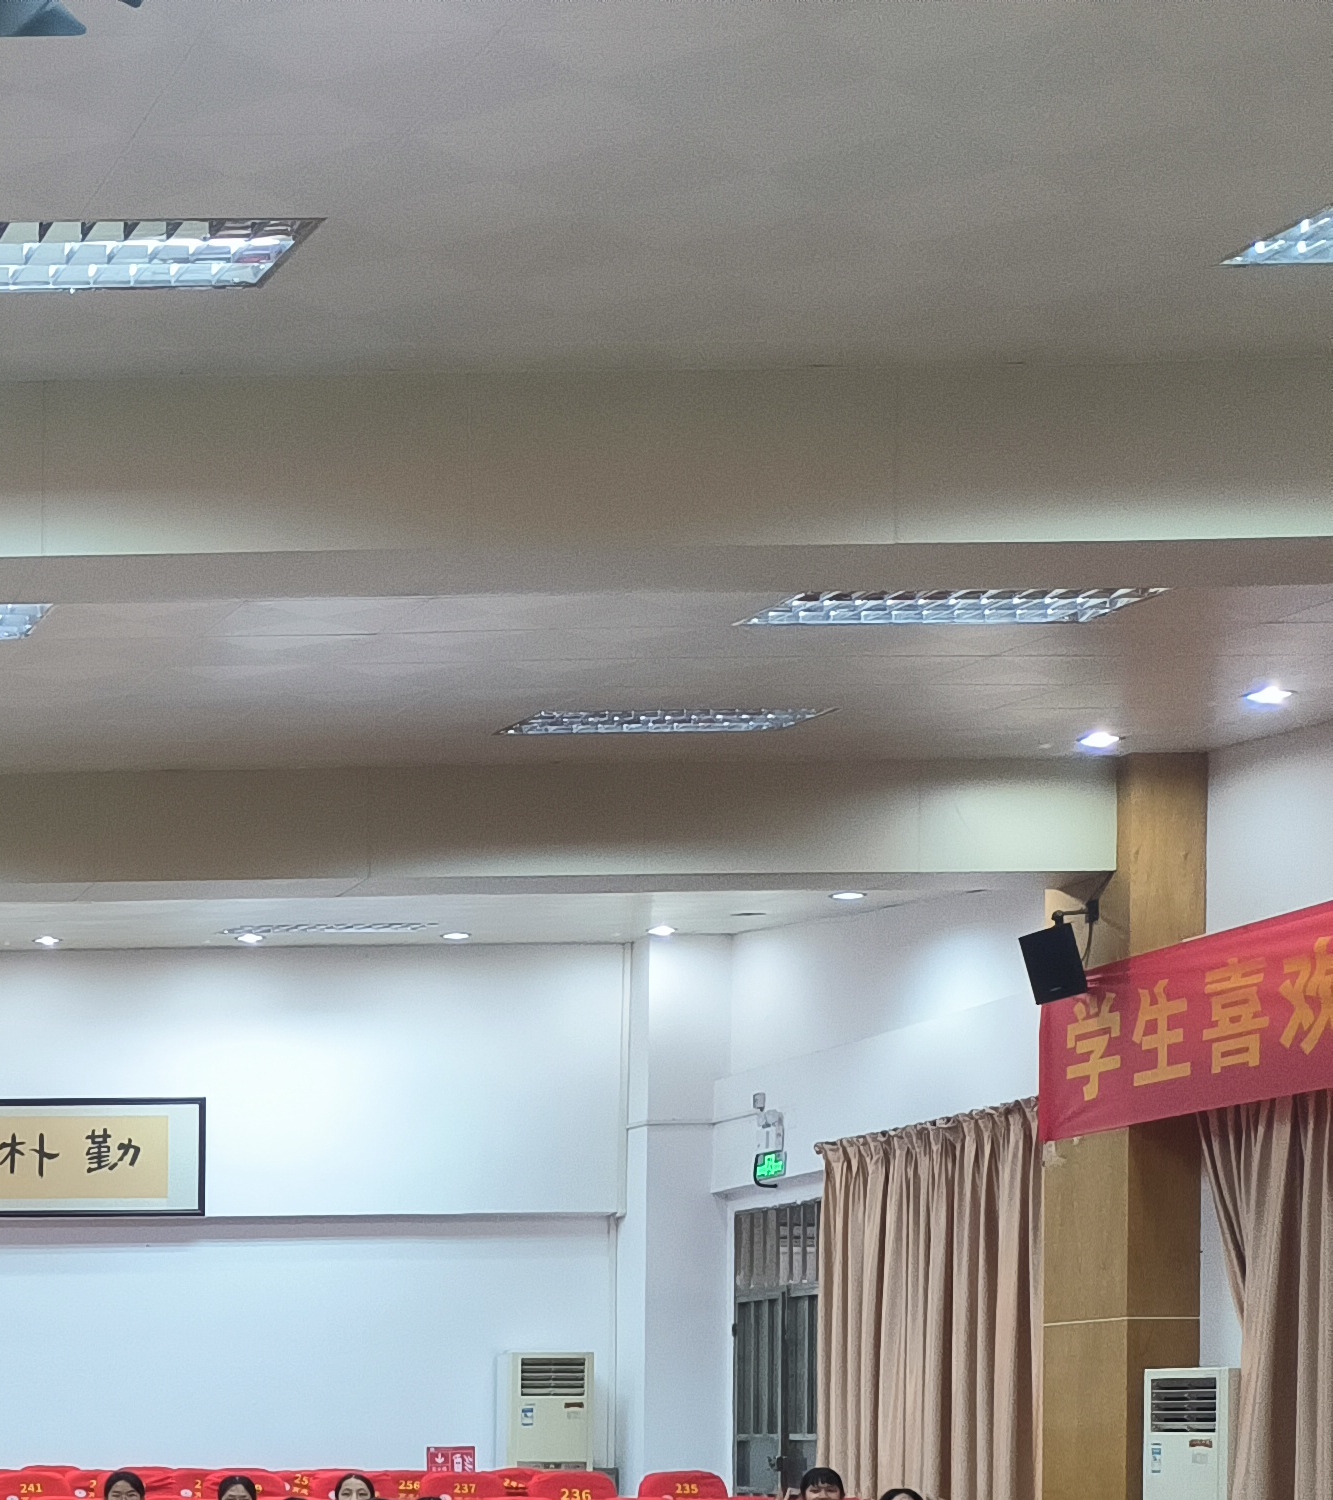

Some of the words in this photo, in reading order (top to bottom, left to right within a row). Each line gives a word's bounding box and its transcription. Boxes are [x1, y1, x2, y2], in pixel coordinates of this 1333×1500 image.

[20, 1483, 43, 1494] 241
[453, 1482, 476, 1494] 237
[560, 1488, 592, 1500] 236
[674, 1483, 699, 1495] 235
